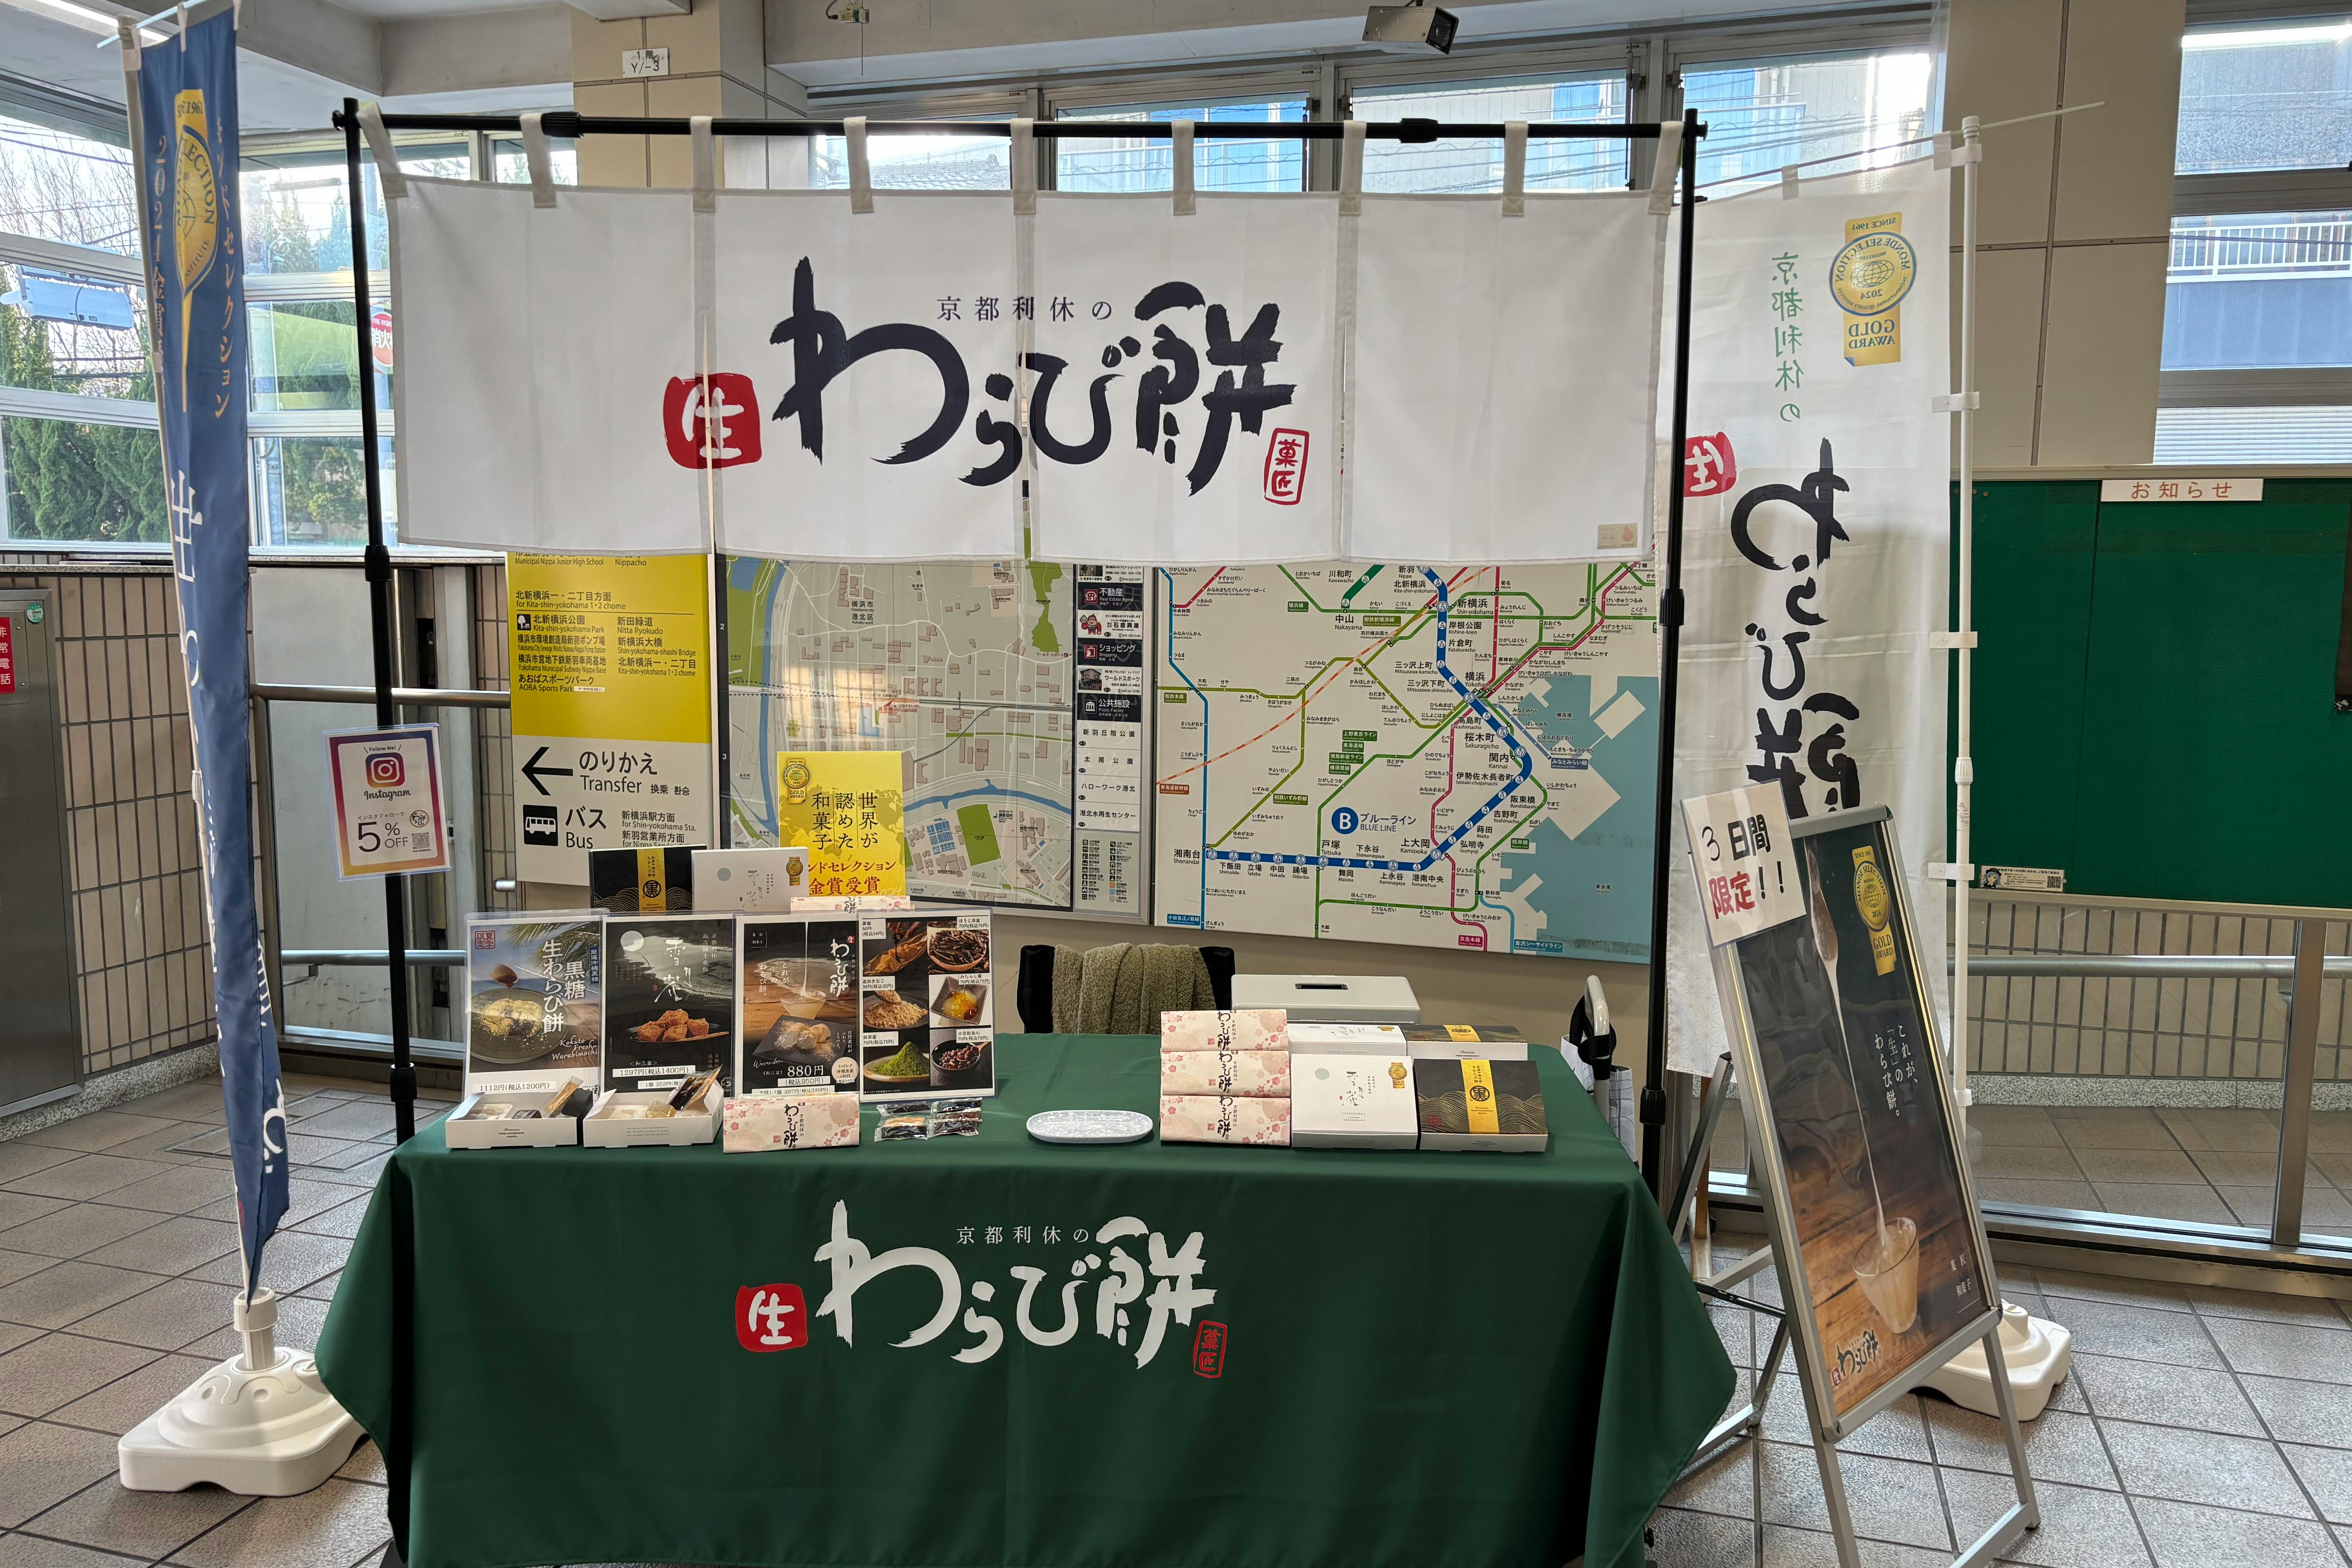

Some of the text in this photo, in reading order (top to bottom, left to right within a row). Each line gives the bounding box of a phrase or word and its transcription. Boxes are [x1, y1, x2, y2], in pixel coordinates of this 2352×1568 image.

[937, 295, 1113, 322] 京都利休の
[683, 255, 1298, 497] 生 わらび餅
[2131, 481, 2232, 499] お知らせ
[516, 590, 611, 601] 北新横浜一・二丁目方面
[1099, 588, 1123, 597] 不動産
[1457, 599, 1488, 608] 新横浜
[534, 615, 585, 625] 北新横浜公園
[617, 617, 653, 627] 新田緑道
[1335, 615, 1354, 623] 中山
[534, 625, 590, 633] Kita-shin-yokohama
[618, 637, 663, 647] 新横浜大橋
[1099, 644, 1136, 652] ショッピング
[618, 647, 696, 657] Shin-yokohama-ohashi Bridge
[564, 665, 581, 674] Subway
[618, 659, 696, 669] 北新横浜一・二丁目
[618, 667, 666, 676] Kita-shin-yokohama
[1465, 672, 1485, 681] 横浜
[519, 674, 594, 685] あおばスポーツパーク
[1099, 699, 1130, 708] 公共施設
[1465, 733, 1495, 743] 桜木町
[579, 751, 658, 775] のりかえ
[1489, 753, 1509, 763] 関内
[1456, 772, 1514, 782] 伊勢佐木長者町
[580, 775, 642, 794] Transfer
[364, 789, 411, 801] Instagram
[566, 805, 607, 829] バス
[622, 810, 675, 823] 新横浜駅方面
[811, 792, 832, 850] 和菓子
[835, 793, 854, 849] 認めた
[859, 792, 878, 847] 世界が
[1339, 813, 1351, 830] B
[1360, 813, 1416, 825] ブルーライン
[633, 821, 683, 830] Shin-yokohama
[358, 821, 408, 852] 5 % OFF
[566, 832, 593, 849] Bus
[622, 830, 685, 843] 新羽営業所方面
[1401, 838, 1430, 848] 上大岡
[1321, 840, 1340, 849] 戸塚
[1174, 849, 1200, 859] 湘南台
[808, 861, 897, 873] ンドセレクション
[809, 876, 880, 895] 金賞受賞
[1863, 866, 1887, 895] SELECTION
[645, 882, 659, 897] 黒
[1872, 910, 1881, 918] 2024
[1873, 934, 1892, 950] GOLD
[1876, 947, 1893, 960] AWARD
[830, 938, 849, 997] わらび餅
[542, 940, 564, 1034] 生わらび餅
[565, 961, 586, 1000] 黒糖
[1217, 1011, 1231, 1050] わらび餅
[560, 1035, 586, 1047] Kokuto
[574, 1040, 594, 1050] Fresh
[552, 1045, 599, 1060] Warabimochi
[1887, 1029, 1903, 1081] 「生」の
[1898, 1025, 1918, 1083] これが、
[787, 1065, 824, 1077] 880円
[1218, 1051, 1232, 1092] わらび餅
[1875, 1034, 1900, 1116] わらび餅。
[1471, 1086, 1489, 1101] 黒
[1217, 1096, 1233, 1137] わらび餅
[784, 1103, 799, 1148] わらび餅
[956, 1225, 1090, 1245] 京都利休の
[748, 1199, 1218, 1370] 生 わらび餅
[1838, 1329, 1878, 1377] わらび餅
